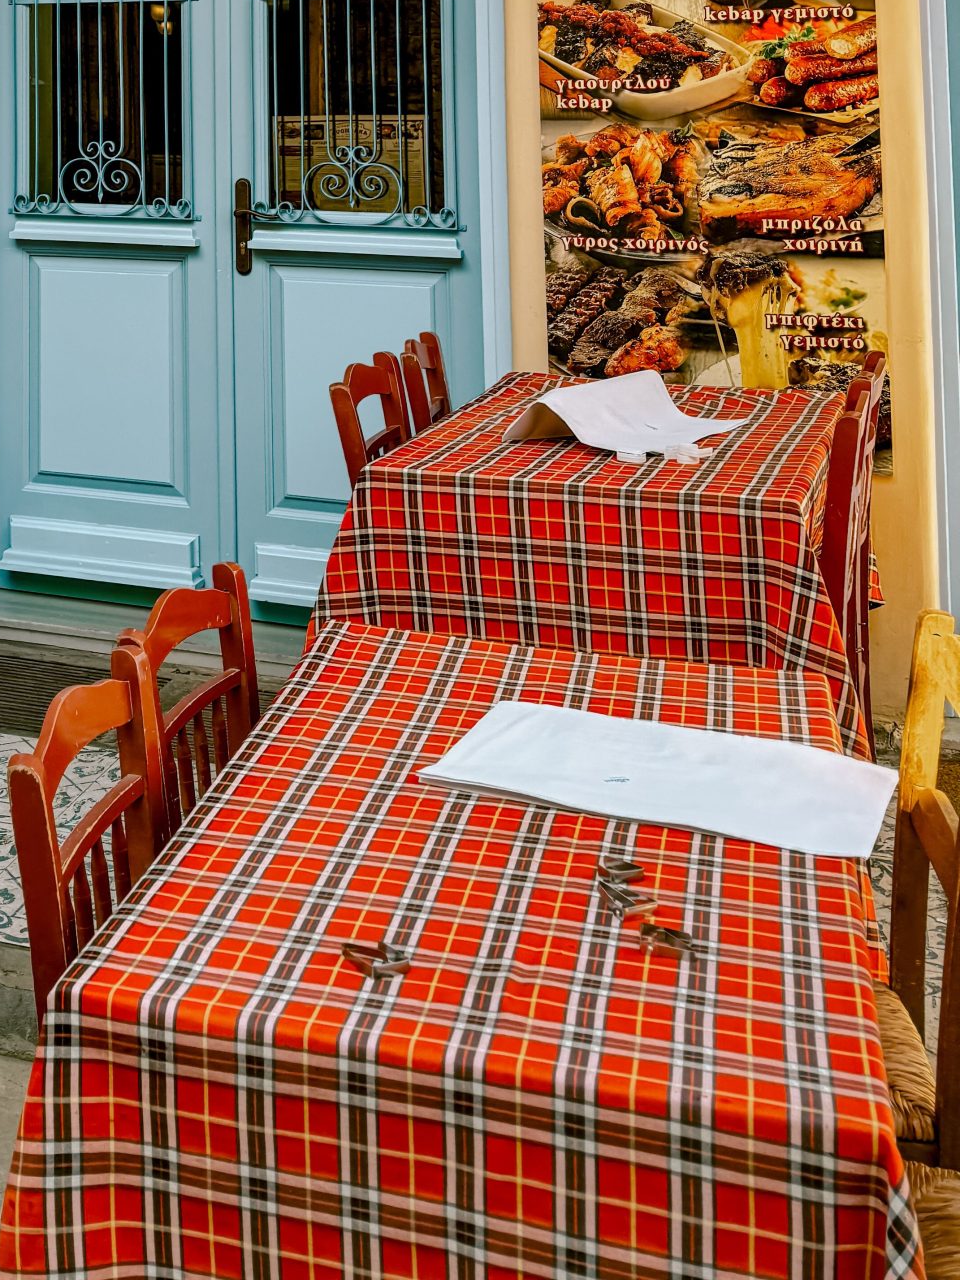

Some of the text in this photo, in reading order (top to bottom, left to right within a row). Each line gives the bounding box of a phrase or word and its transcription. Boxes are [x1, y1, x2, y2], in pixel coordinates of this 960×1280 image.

[704, 5, 854, 23] kebap γεμιστό
[555, 75, 672, 93] γιαουρτλού
[556, 94, 613, 112] kebap
[761, 216, 862, 235] μπριζόλα
[561, 234, 709, 255] γύρος χοιρινός
[783, 236, 863, 255] χοιρινή
[764, 312, 865, 331] μπιφτέκι
[780, 332, 865, 351] γεμιστό
